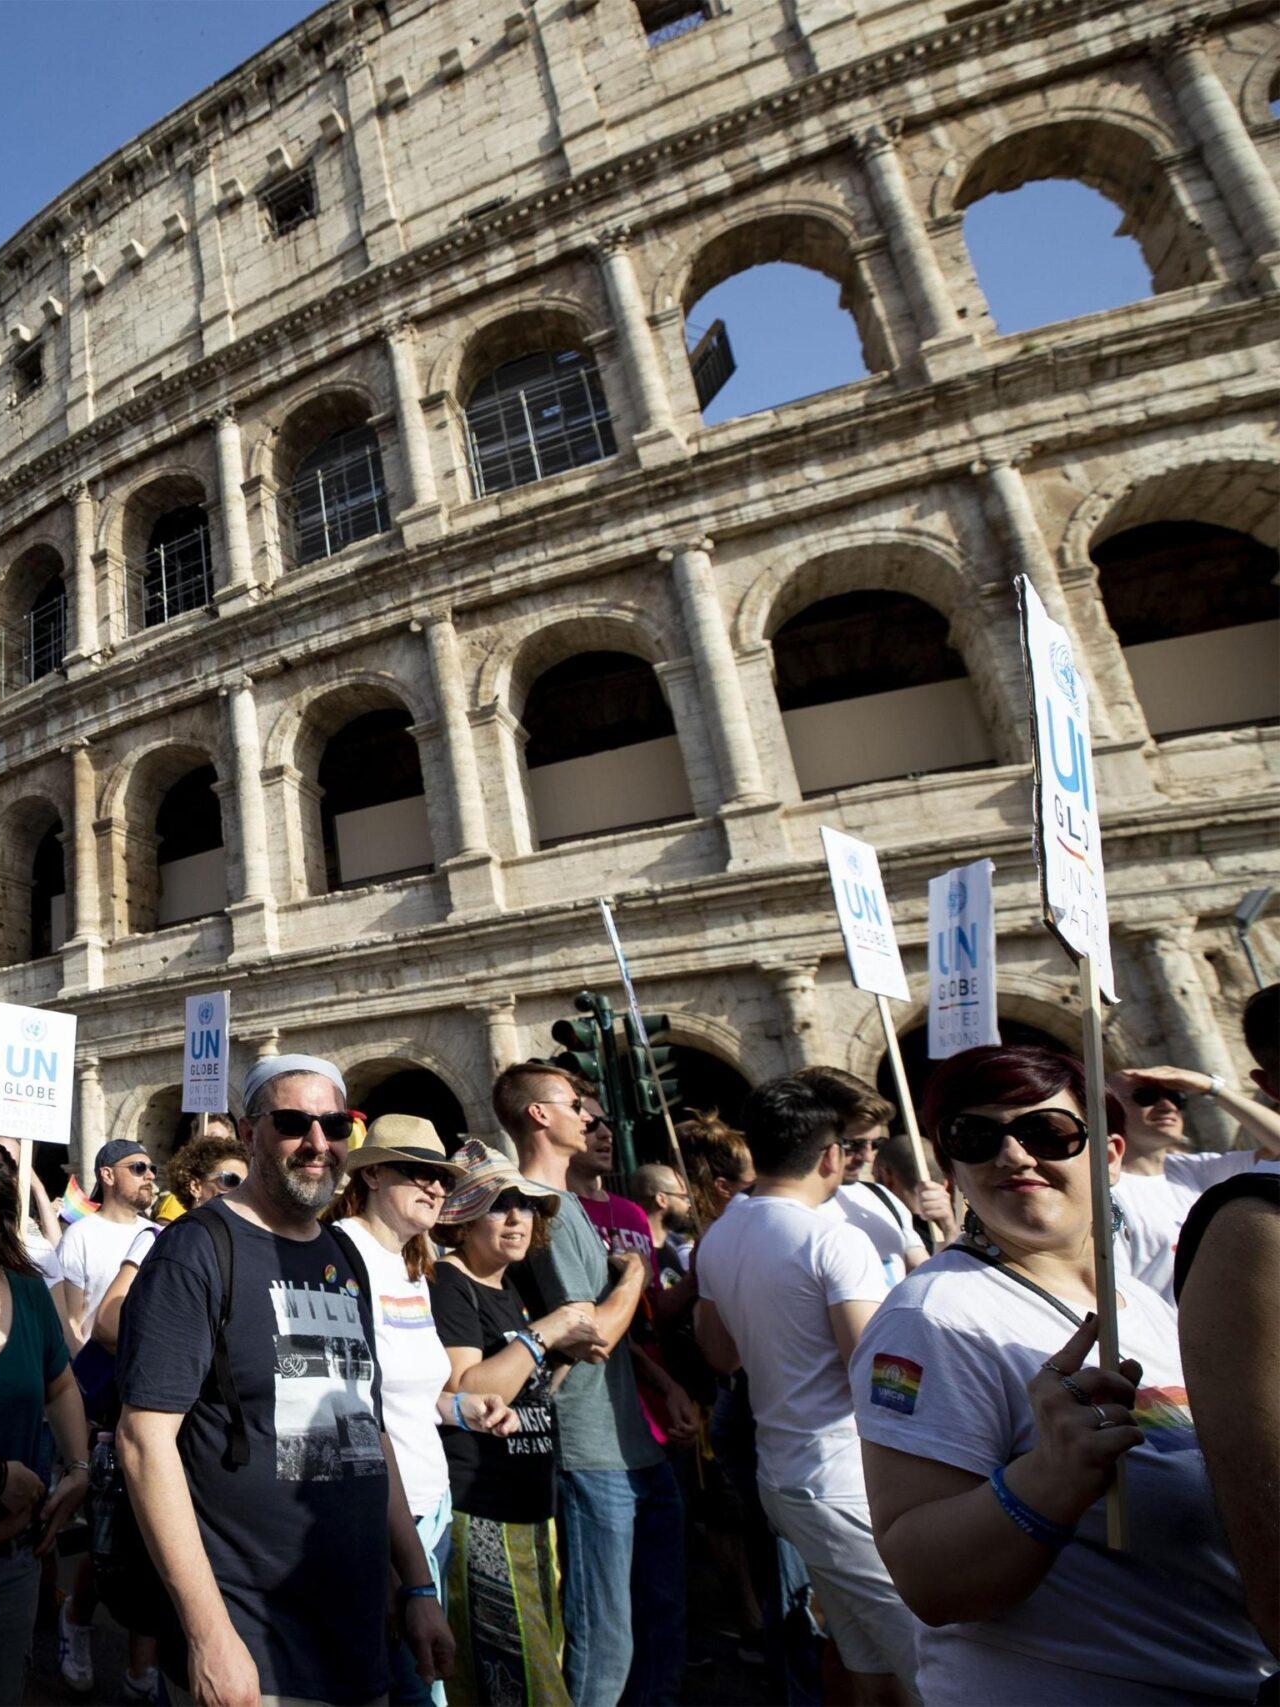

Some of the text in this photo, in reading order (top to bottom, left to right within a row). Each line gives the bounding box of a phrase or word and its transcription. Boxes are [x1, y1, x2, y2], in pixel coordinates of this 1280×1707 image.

[842, 878, 883, 927] UN
[938, 977, 979, 1001] GOBE
[191, 1029, 220, 1060] UN
[5, 1044, 58, 1083] UN
[189, 1063, 219, 1076] GLOBE
[3, 1081, 56, 1101] GLOBE
